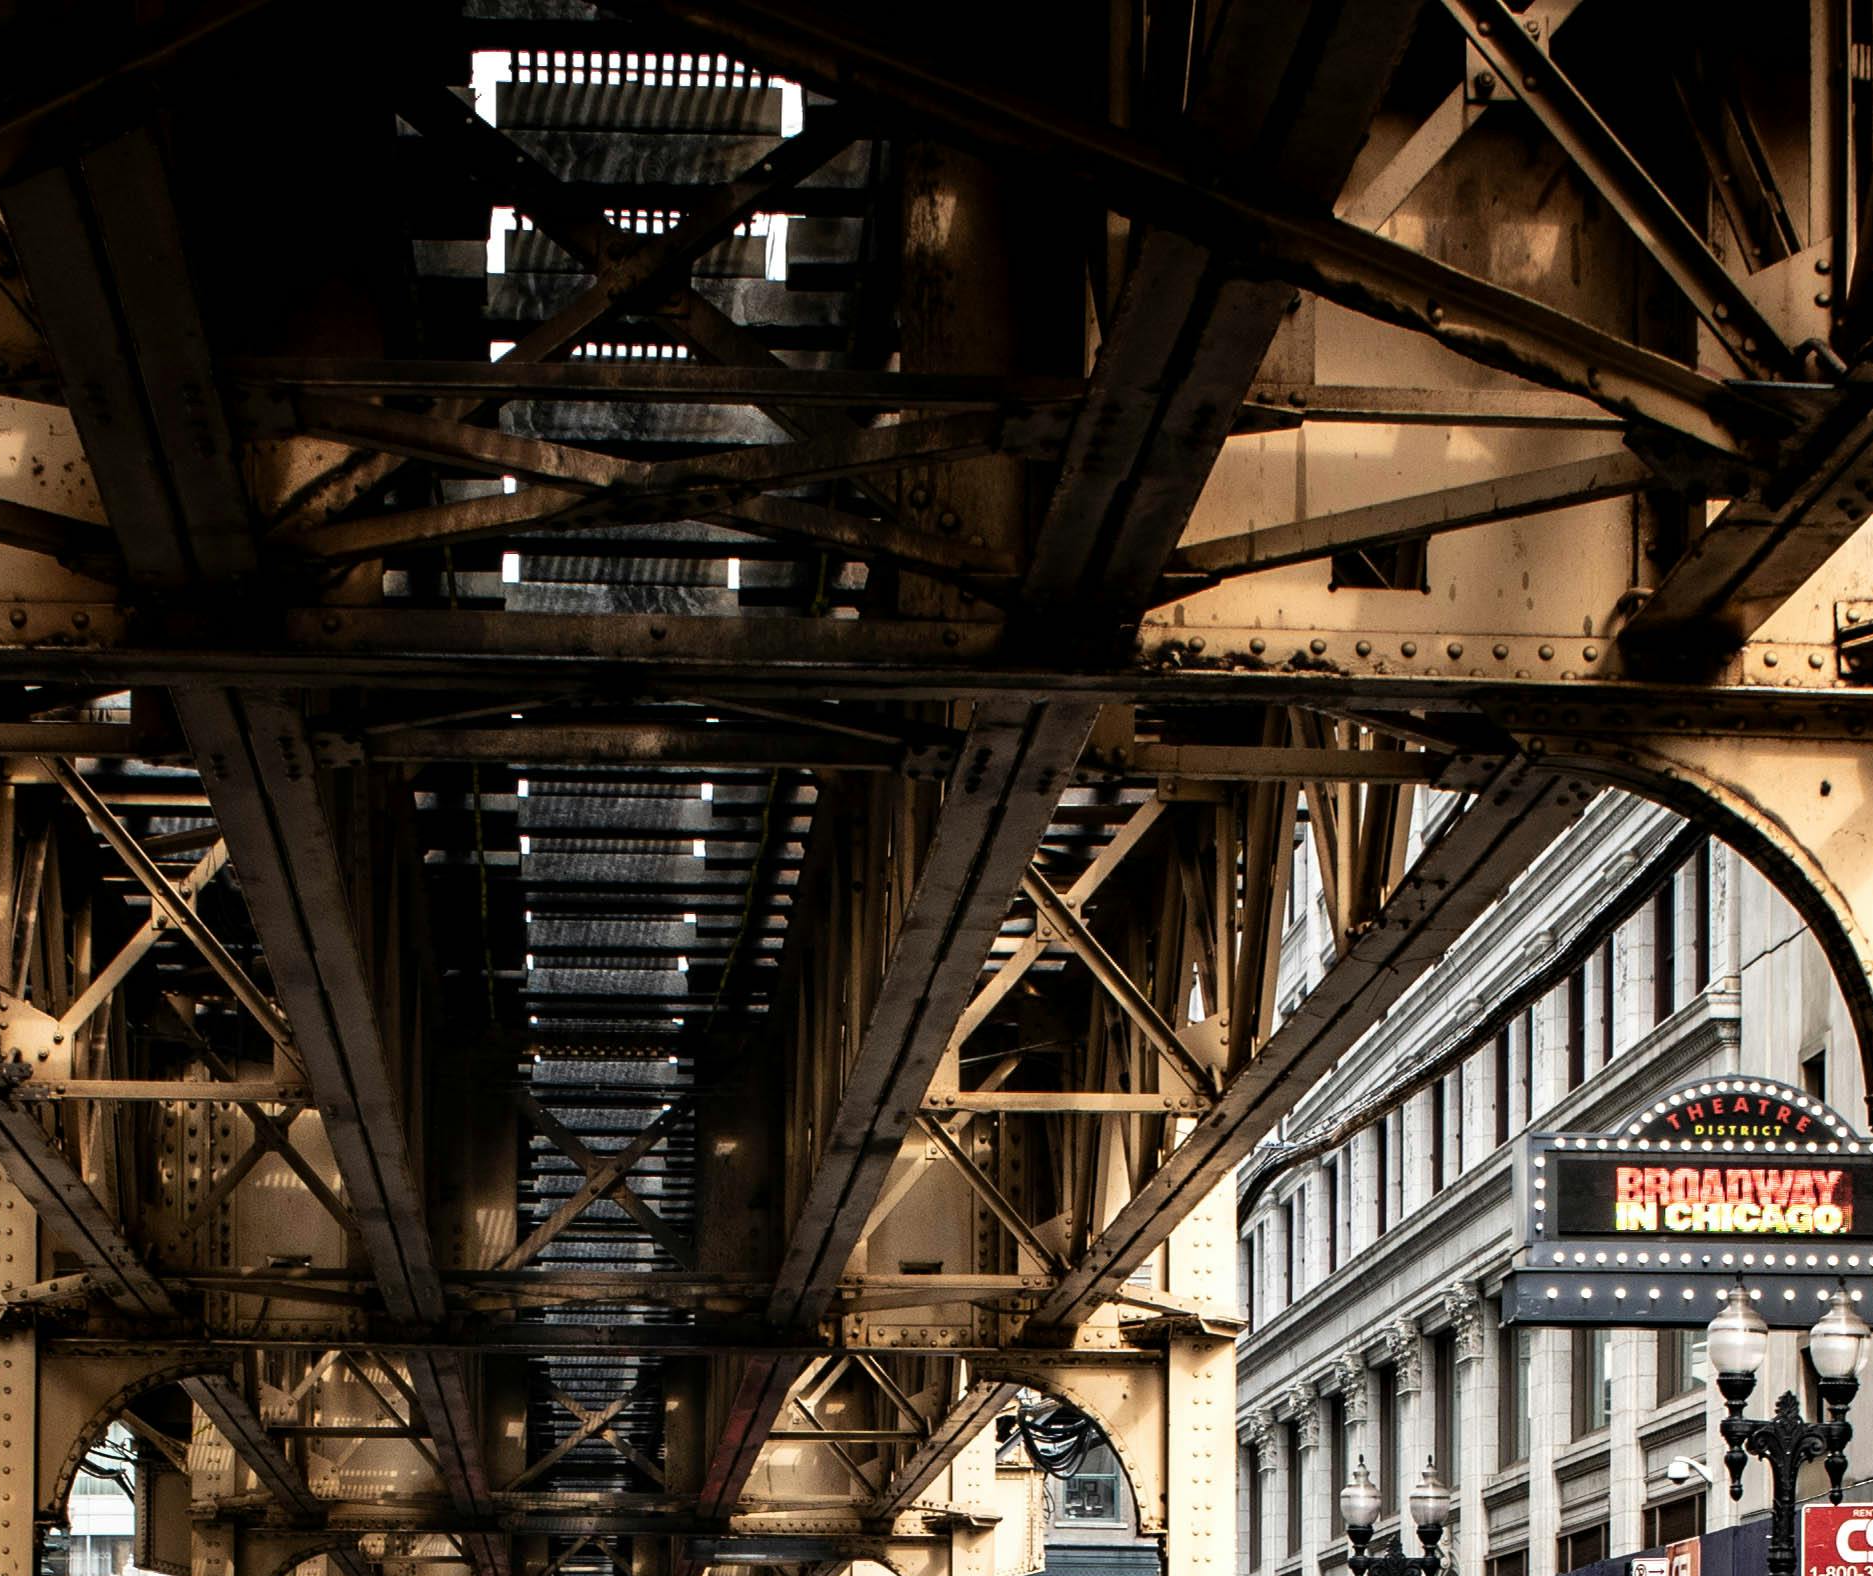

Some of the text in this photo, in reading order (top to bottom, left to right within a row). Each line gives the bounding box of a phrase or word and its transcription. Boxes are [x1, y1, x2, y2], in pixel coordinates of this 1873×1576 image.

[1666, 1097, 1812, 1134] THEATRE
[1694, 1124, 1781, 1137] DISTRICT
[1615, 1166, 1843, 1208] BROADWAY
[1615, 1202, 1657, 1231] IN
